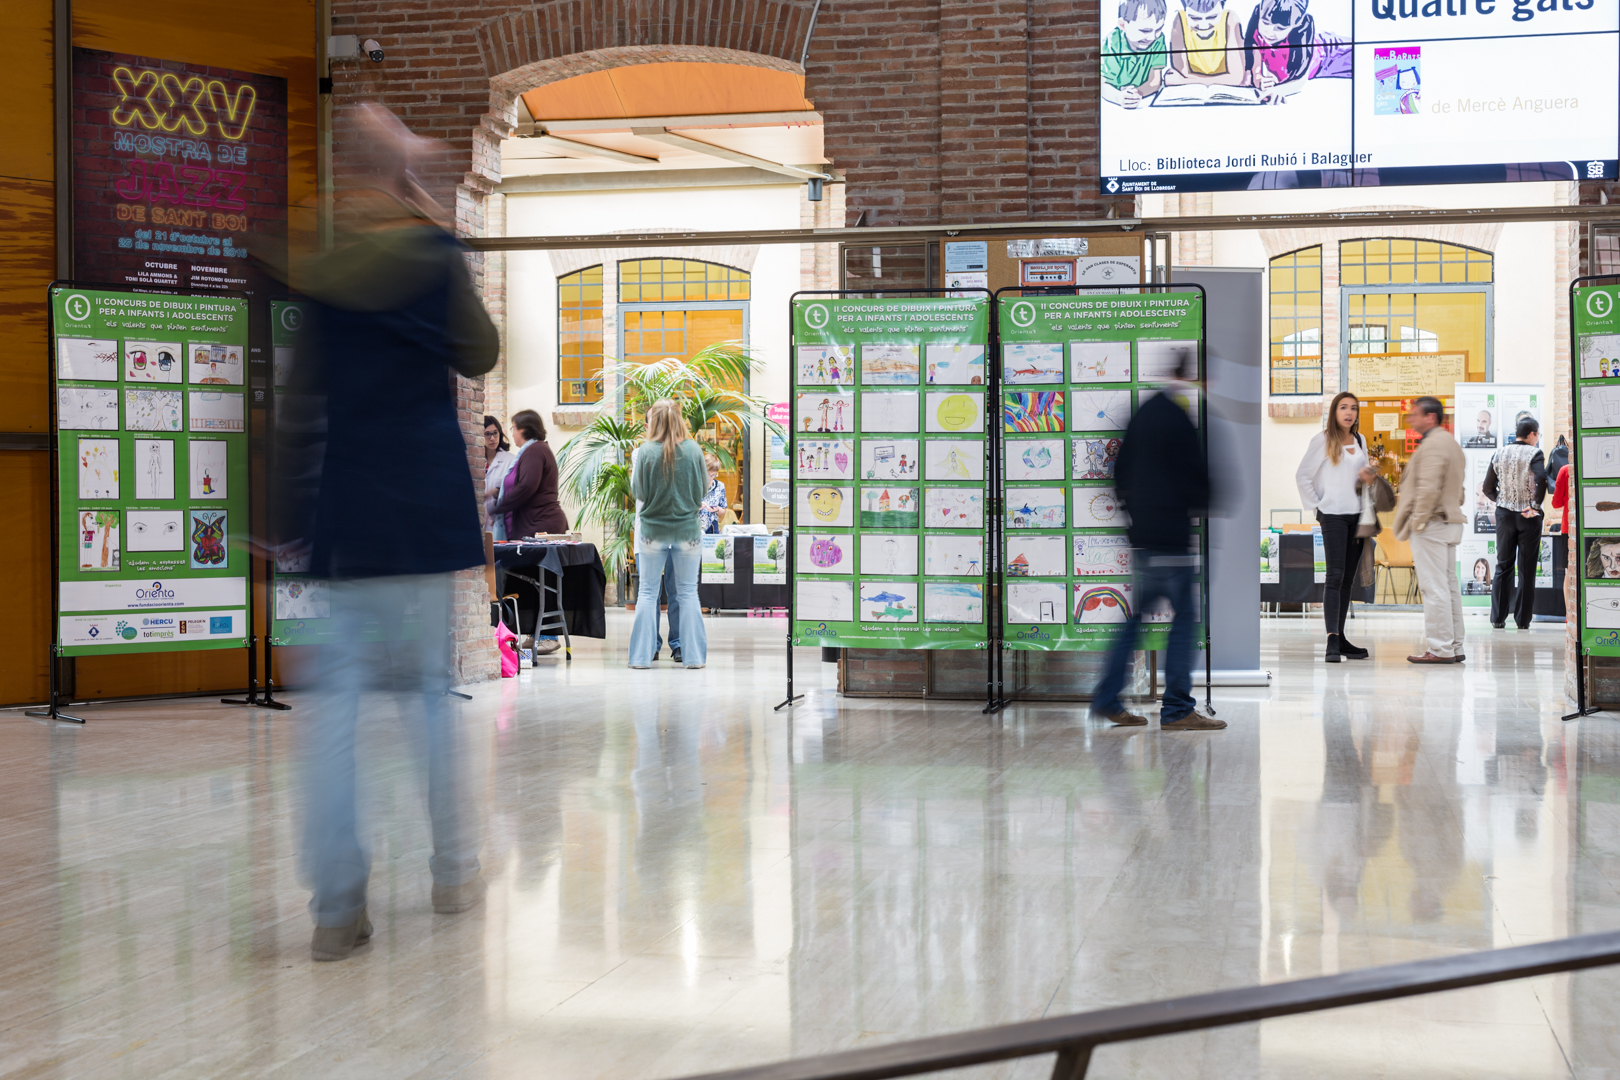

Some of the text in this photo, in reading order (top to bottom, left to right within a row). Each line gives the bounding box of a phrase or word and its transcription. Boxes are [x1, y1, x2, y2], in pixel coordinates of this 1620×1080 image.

[1371, 0, 1595, 22] Quatre gats
[112, 66, 256, 140] XXV
[1431, 96, 1579, 114] de Mercè Anguera
[113, 131, 248, 165] MOSTRA DE
[1119, 152, 1373, 171] Lloc: Biblioteca Jordi Rubió i Balaguer
[116, 159, 247, 211] JAZZ
[116, 203, 247, 232] DE SANT BOI
[134, 228, 153, 239] del
[169, 231, 221, 246] d'octubre
[222, 237, 233, 246] al
[135, 239, 150, 250] de
[152, 243, 206, 255] novembre
[207, 245, 221, 256] de
[223, 247, 248, 259] 2016
[145, 261, 178, 270] OCTUBRE
[191, 265, 228, 274] NOVEMBRE
[1086, 264, 1094, 272] DAN
[1116, 261, 1137, 275] ESPERANTO
[95, 297, 102, 305] II
[103, 298, 147, 308] CONCURS
[149, 300, 161, 309] DE
[163, 301, 193, 311] DIBUIX
[199, 302, 237, 313] PINTURA
[841, 305, 885, 313] CONCURS
[886, 305, 898, 313] DE
[900, 304, 931, 312] DIBUIX
[938, 304, 978, 312] PINTURA
[1048, 302, 1094, 310] CONCURS
[1110, 300, 1142, 309] DIBUIX
[1150, 299, 1190, 308] PINTURA
[99, 307, 117, 316] PER
[118, 309, 126, 317] A
[127, 309, 165, 319] INFANTS
[171, 311, 234, 322] ADOLESCENTS
[856, 314, 863, 322] A
[864, 314, 902, 322] INFANTS
[909, 314, 974, 322] ADOLESCENTS
[1044, 312, 1063, 320] PER
[1064, 311, 1072, 319] A
[1073, 310, 1112, 319] INFANTS
[1120, 309, 1187, 318] ADOLESCENTS
[136, 588, 174, 599] Orienta
[143, 630, 174, 639] totimprès
[284, 627, 315, 635] Orienta
[805, 628, 837, 637] Orienta
[1016, 630, 1050, 639] Orienta
